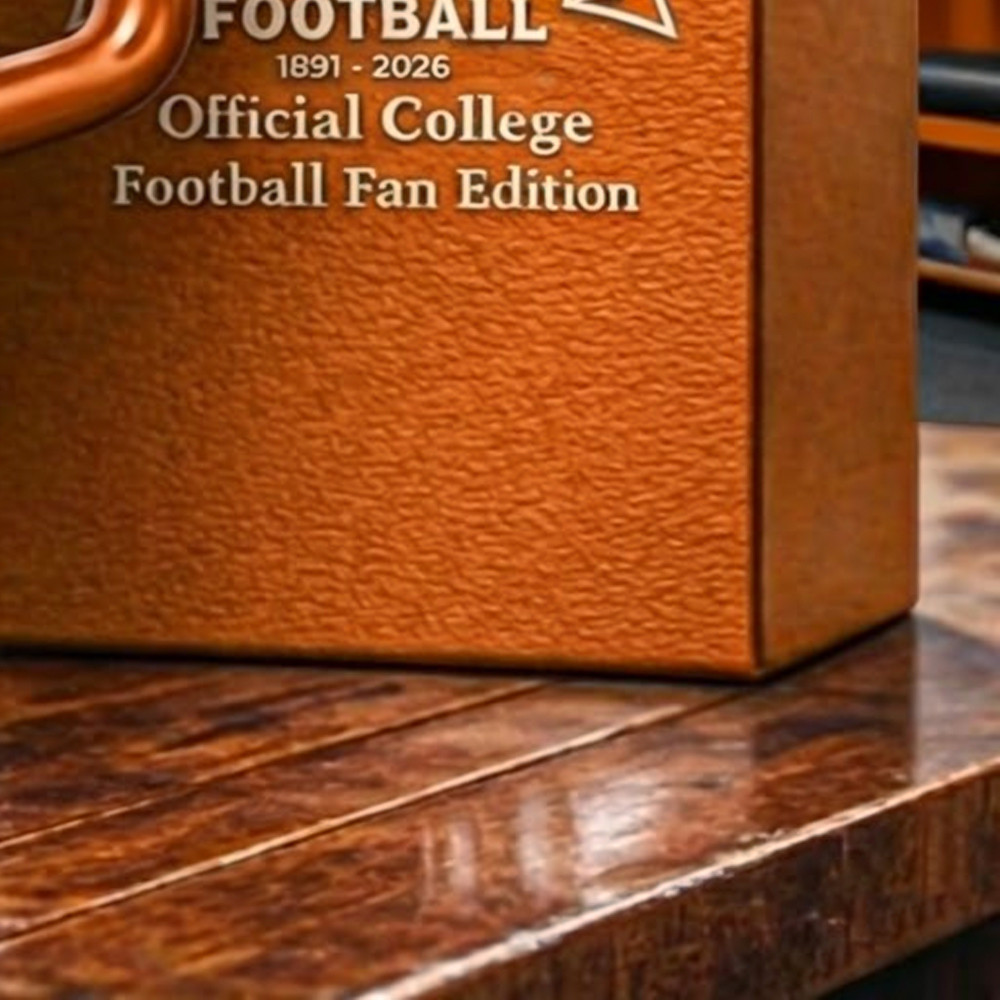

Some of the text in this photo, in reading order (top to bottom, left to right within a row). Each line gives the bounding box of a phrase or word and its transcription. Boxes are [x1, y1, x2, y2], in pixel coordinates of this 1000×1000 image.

[276, 54, 341, 79] 1891
[372, 54, 451, 79] 2026
[158, 93, 595, 156] Official College
[113, 161, 640, 212] Football Fan Edition
